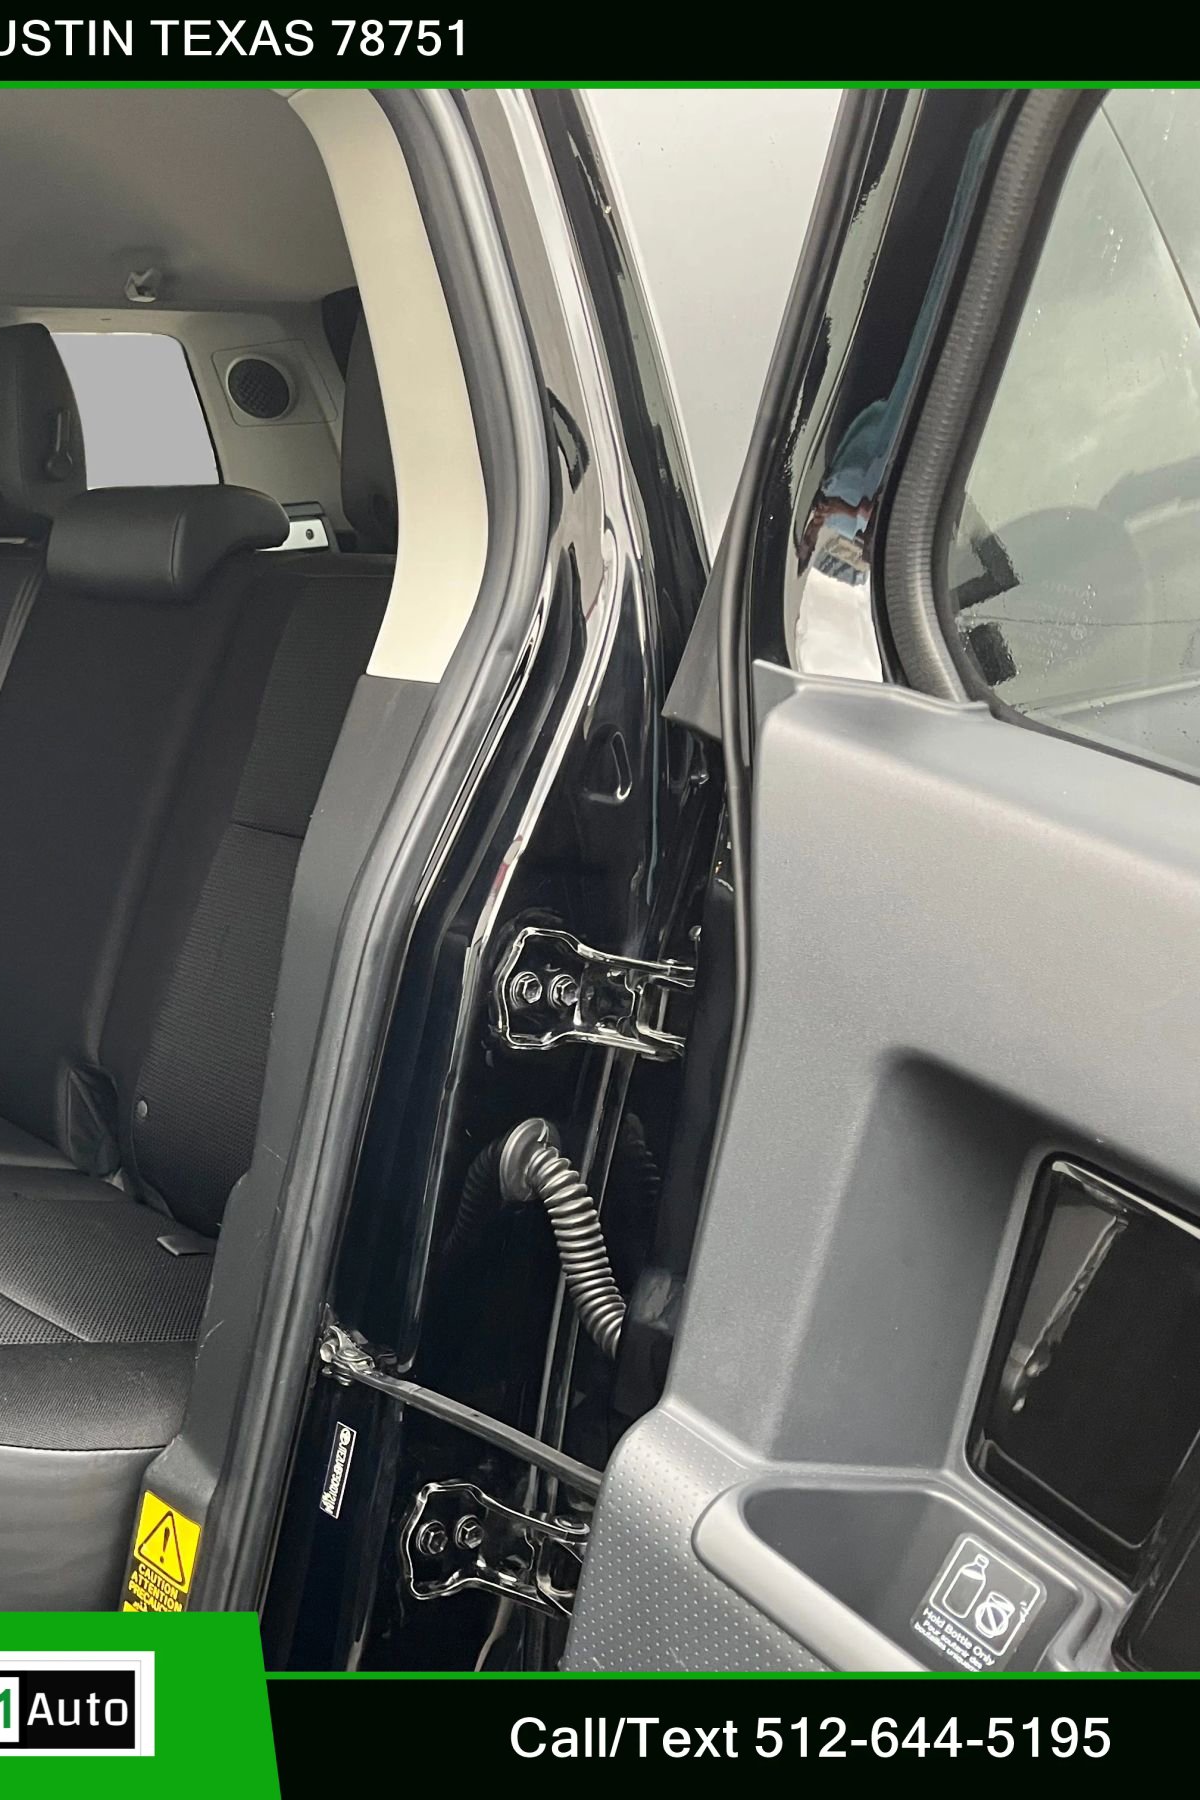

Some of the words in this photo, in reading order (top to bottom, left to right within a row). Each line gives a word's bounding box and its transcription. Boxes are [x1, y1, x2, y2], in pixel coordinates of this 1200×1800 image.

[130, 1570, 183, 1612] ATTENTION
[138, 1563, 179, 1600] CAUTION
[922, 1619, 941, 1636] Pour
[923, 1607, 946, 1629] Hold
[943, 1623, 973, 1650] Bottle
[972, 1645, 996, 1667] Only
